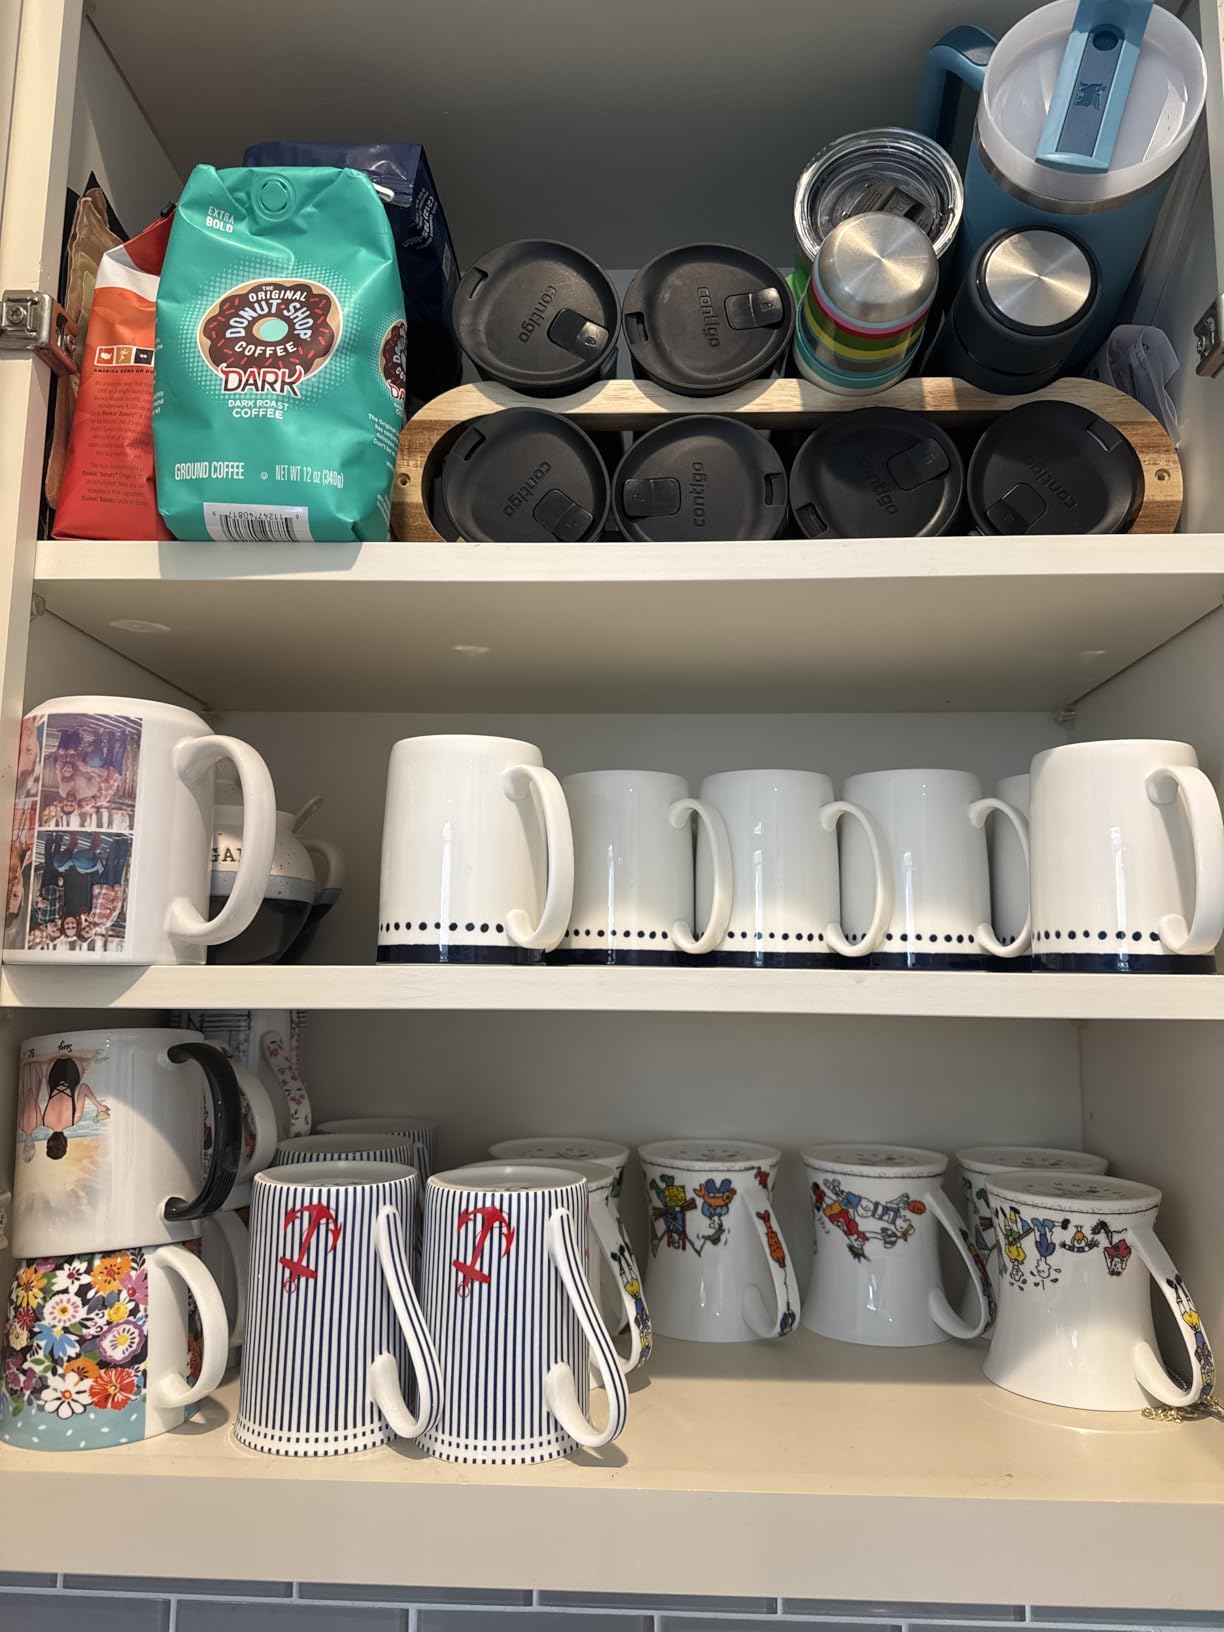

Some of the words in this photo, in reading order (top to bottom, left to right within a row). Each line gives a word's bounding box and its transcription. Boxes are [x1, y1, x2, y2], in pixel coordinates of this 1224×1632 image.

[206, 216, 233, 233] BOLD
[208, 206, 234, 225] EXTRA
[248, 290, 308, 302] ORIGINAL
[225, 299, 282, 338] DONUT
[283, 301, 314, 340] SHOP
[519, 285, 558, 343] contigo
[696, 285, 721, 348] contigo
[234, 341, 298, 358] COFFEE
[219, 363, 305, 399] DARK
[228, 399, 255, 408] DARK
[256, 399, 289, 411] ROAST
[232, 408, 284, 420] COFFEE
[174, 461, 209, 481] GROUND
[211, 461, 245, 480] COFFEE
[275, 465, 289, 481] NET
[289, 465, 301, 481] WT
[303, 466, 312, 483] 12
[313, 471, 321, 484] oz
[322, 469, 344, 489] (340g)
[503, 461, 551, 518] contigo
[689, 461, 708, 528] contigo
